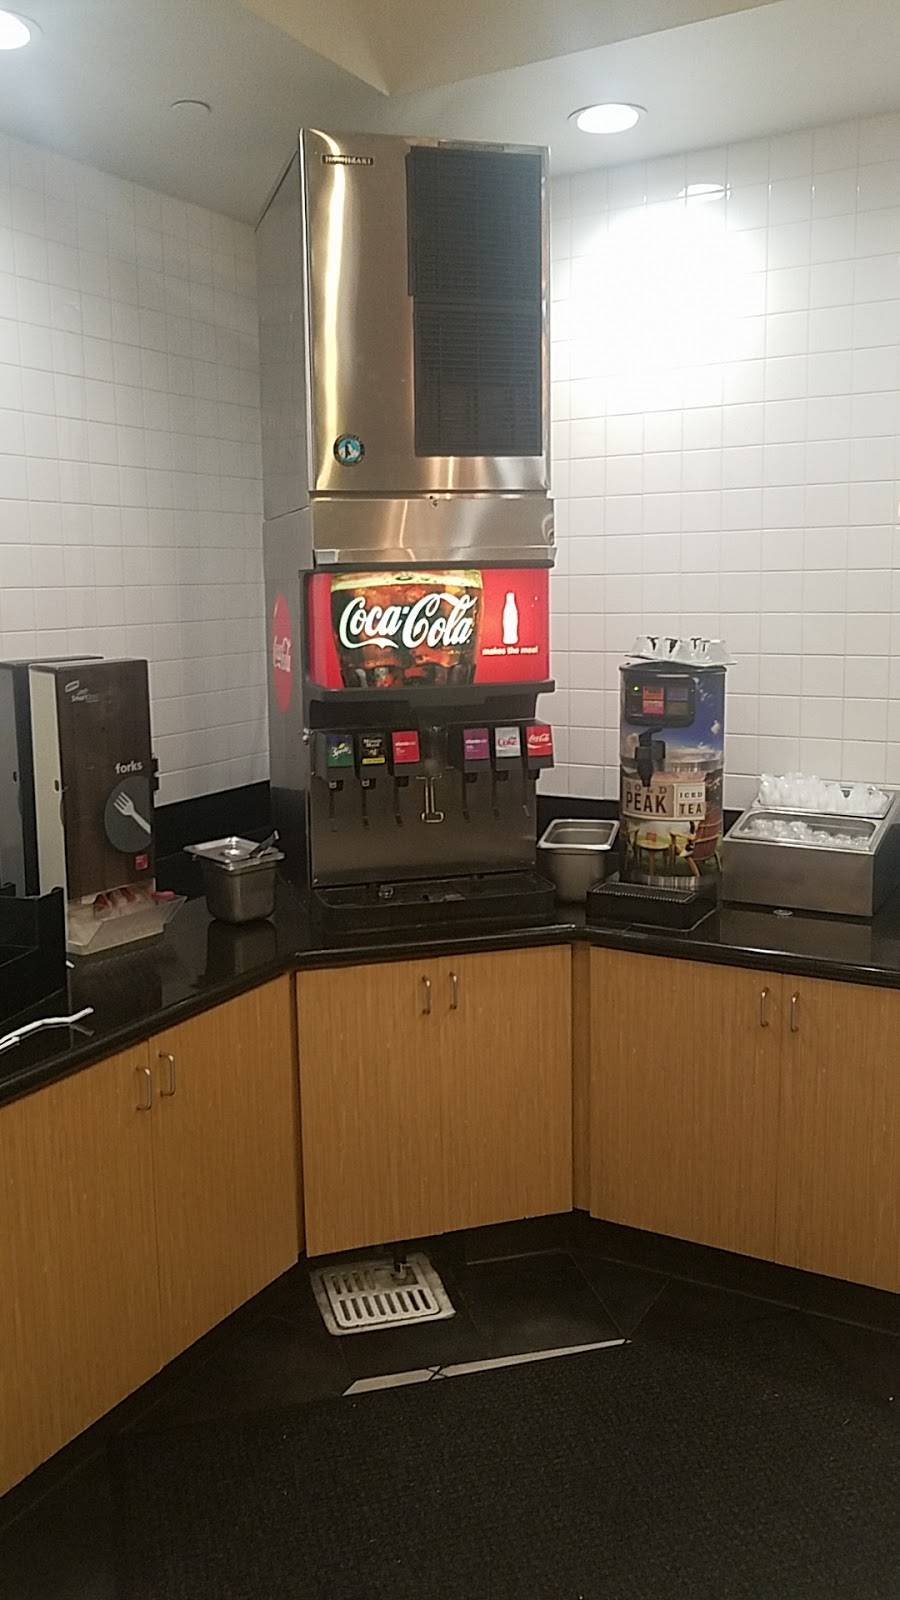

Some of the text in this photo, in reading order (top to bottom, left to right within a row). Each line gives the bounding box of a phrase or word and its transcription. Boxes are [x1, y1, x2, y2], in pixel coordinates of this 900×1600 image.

[339, 592, 478, 649] Coca-Cola
[507, 646, 520, 655] the
[115, 760, 143, 774] forks
[679, 791, 703, 799] ICED
[625, 791, 667, 813] PEAK
[679, 803, 702, 814] TEA
